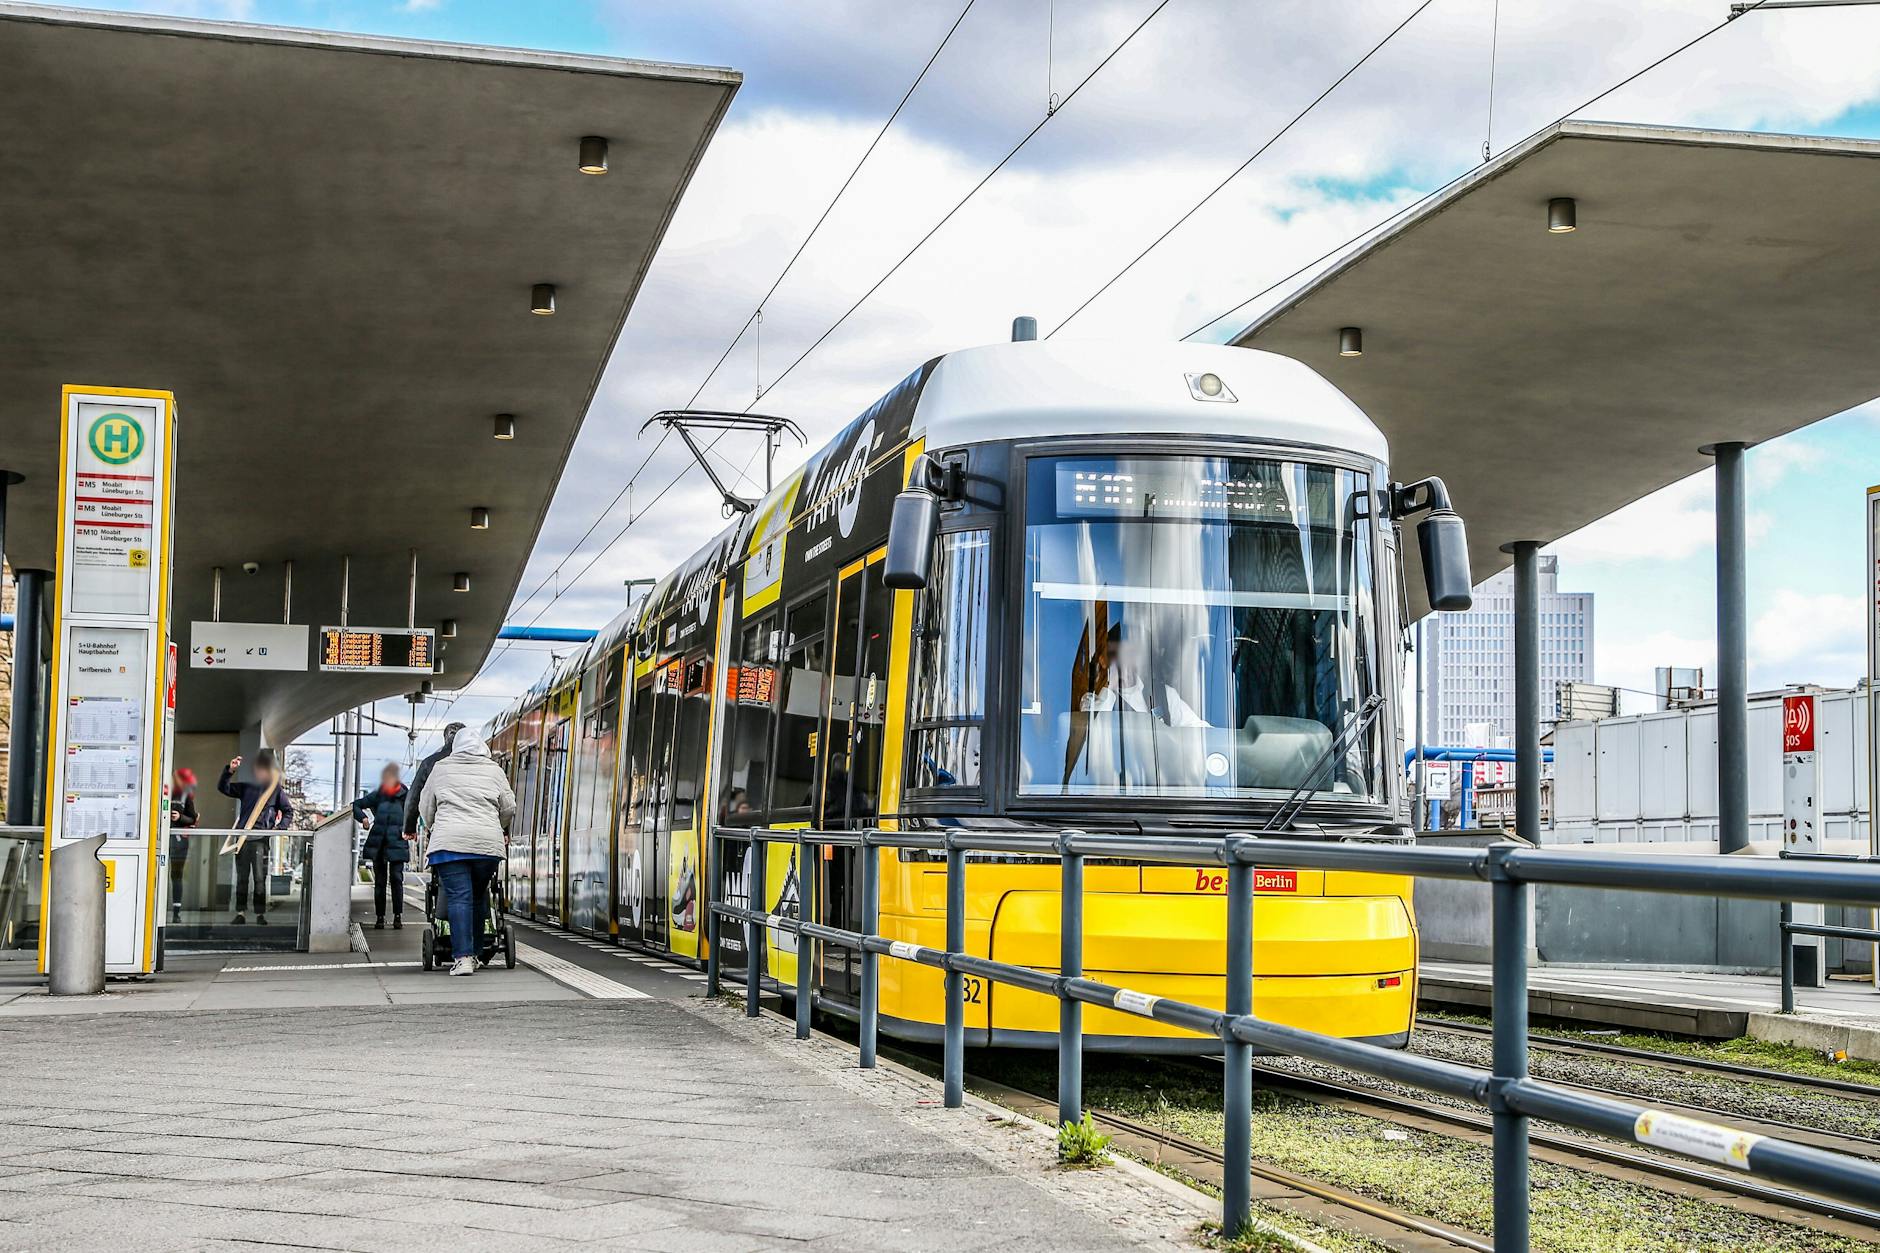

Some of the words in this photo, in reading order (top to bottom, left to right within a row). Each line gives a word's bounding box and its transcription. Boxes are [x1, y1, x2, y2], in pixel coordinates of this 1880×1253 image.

[104, 425, 129, 453] H
[1786, 734, 1800, 746] SOS
[1196, 869, 1222, 890] be
[1256, 874, 1293, 888] Berlin
